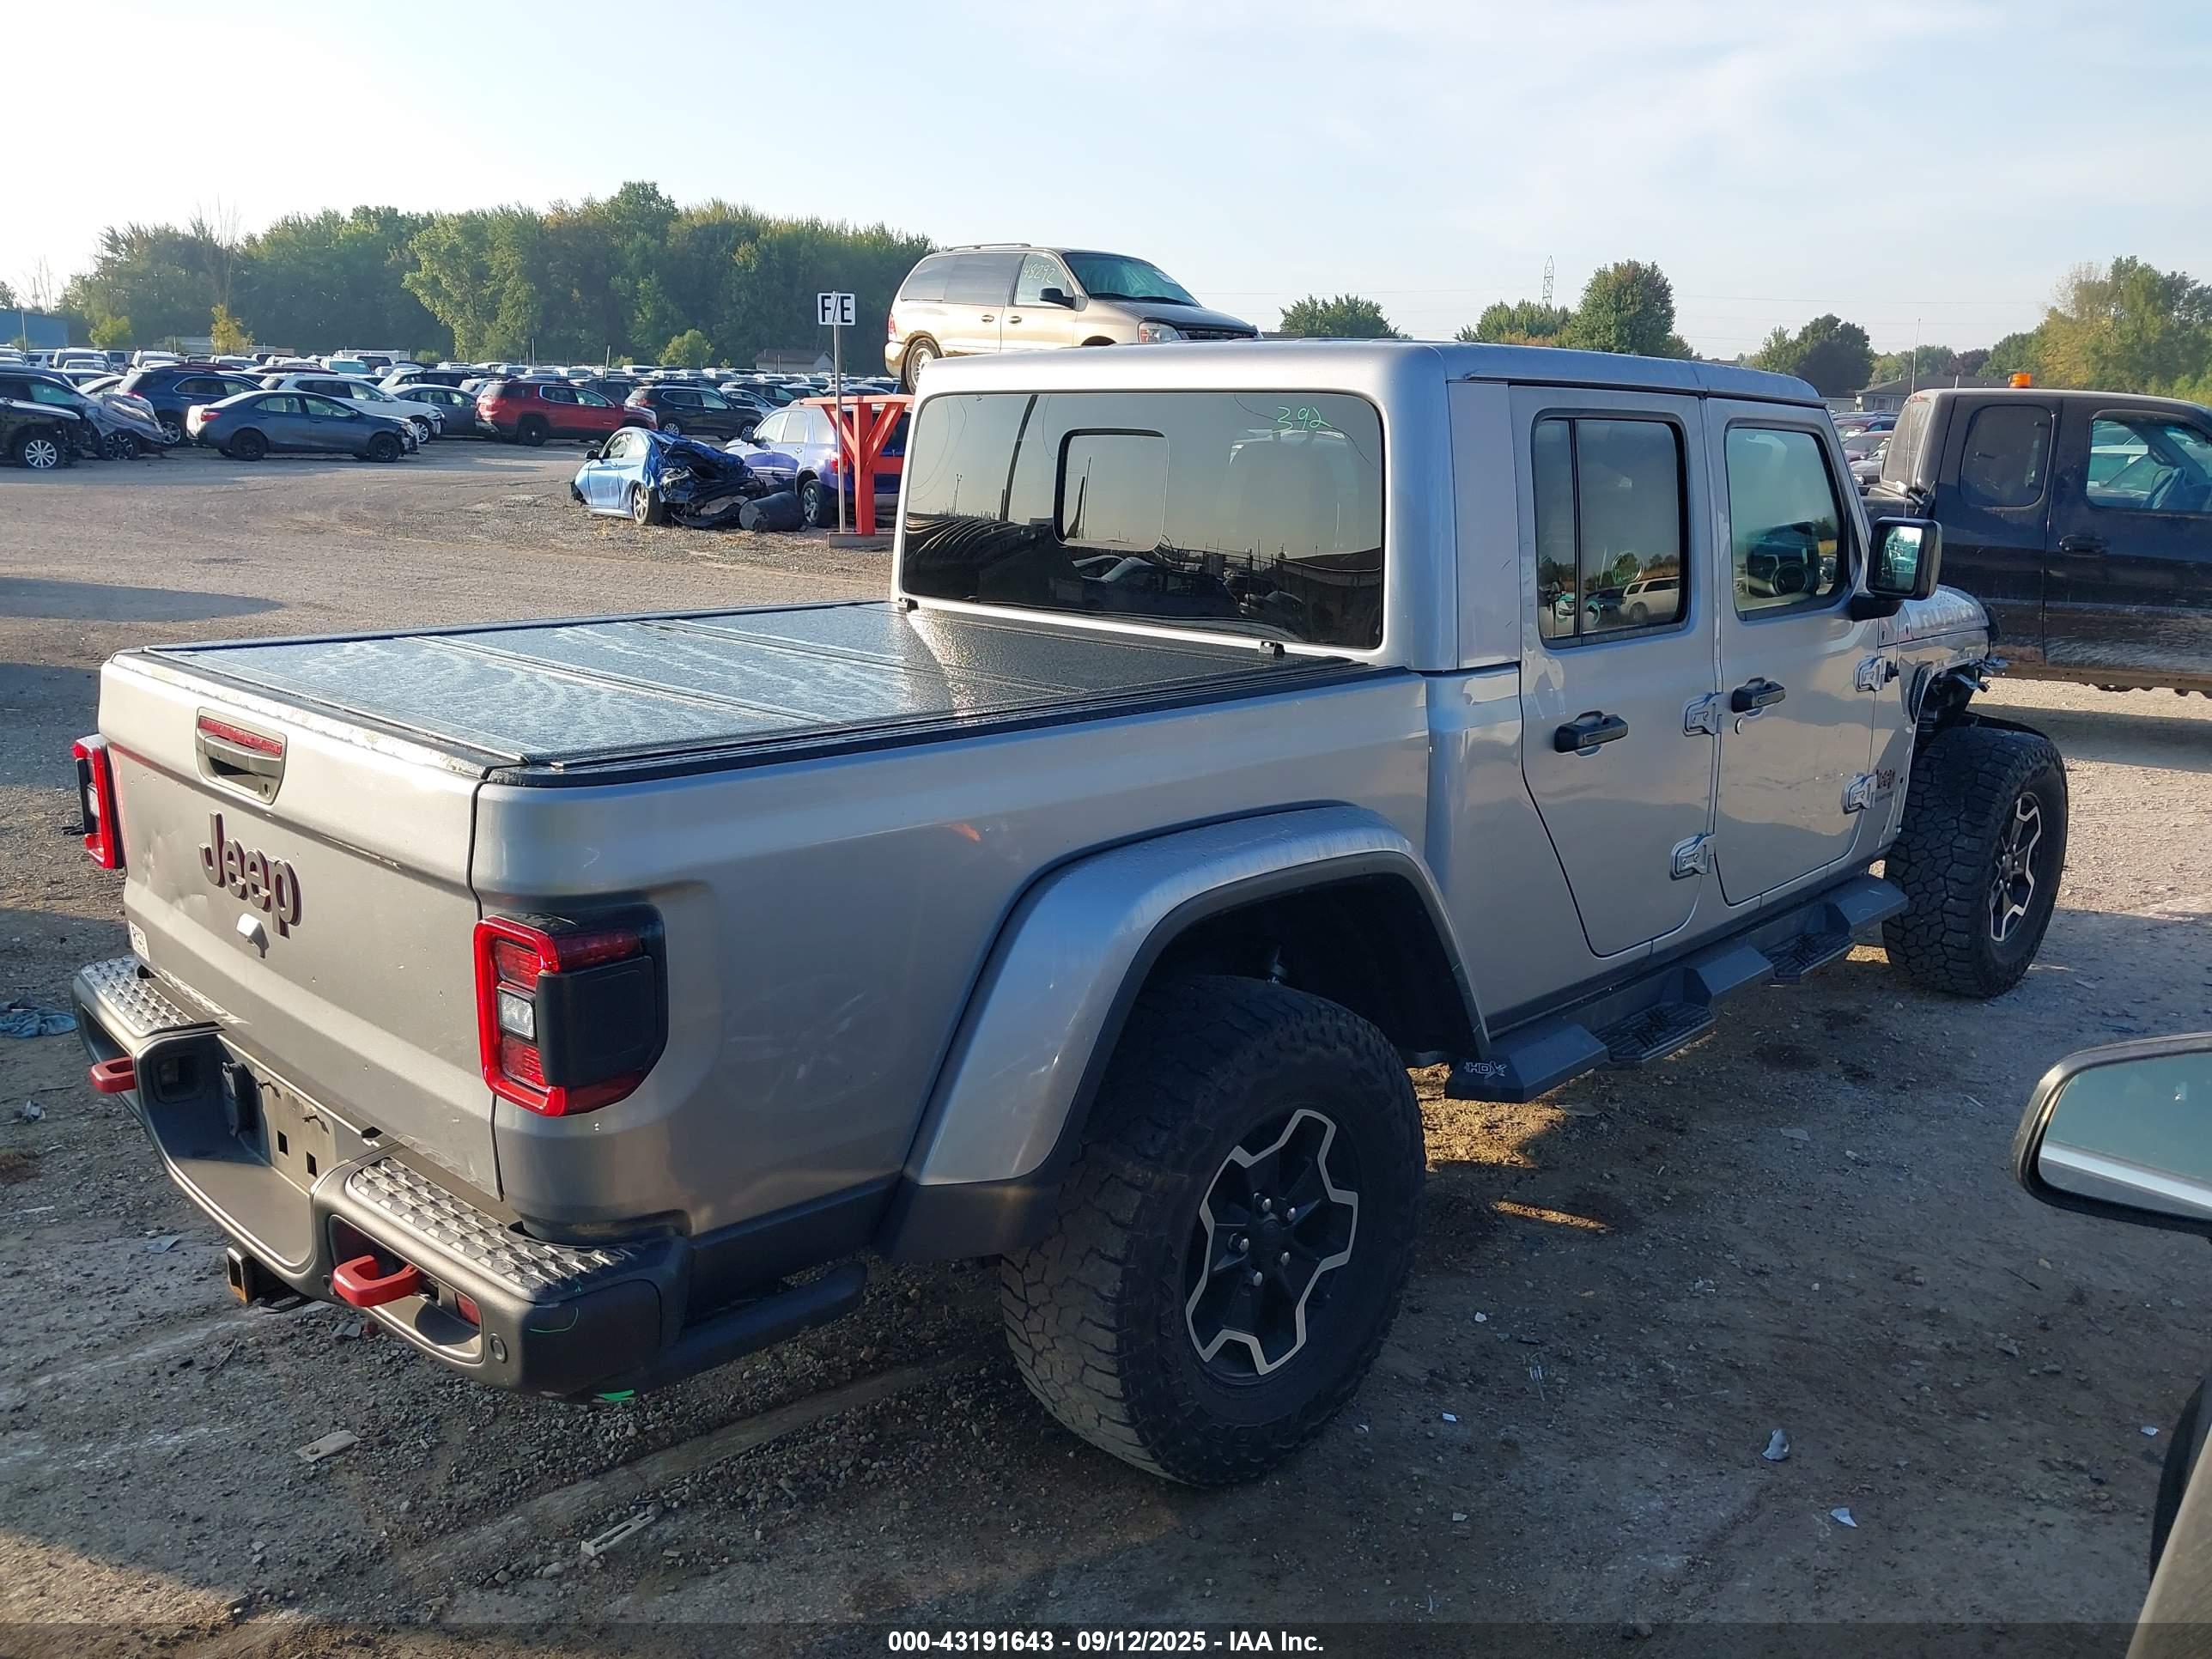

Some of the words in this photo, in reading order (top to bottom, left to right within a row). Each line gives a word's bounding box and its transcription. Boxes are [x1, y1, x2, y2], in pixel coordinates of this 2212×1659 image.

[1024, 262, 1056, 284] 48292
[821, 295, 853, 323] F/E
[1272, 405, 1333, 434] 392
[198, 810, 302, 939] Jeep
[1464, 1060, 1508, 1079] HDX
